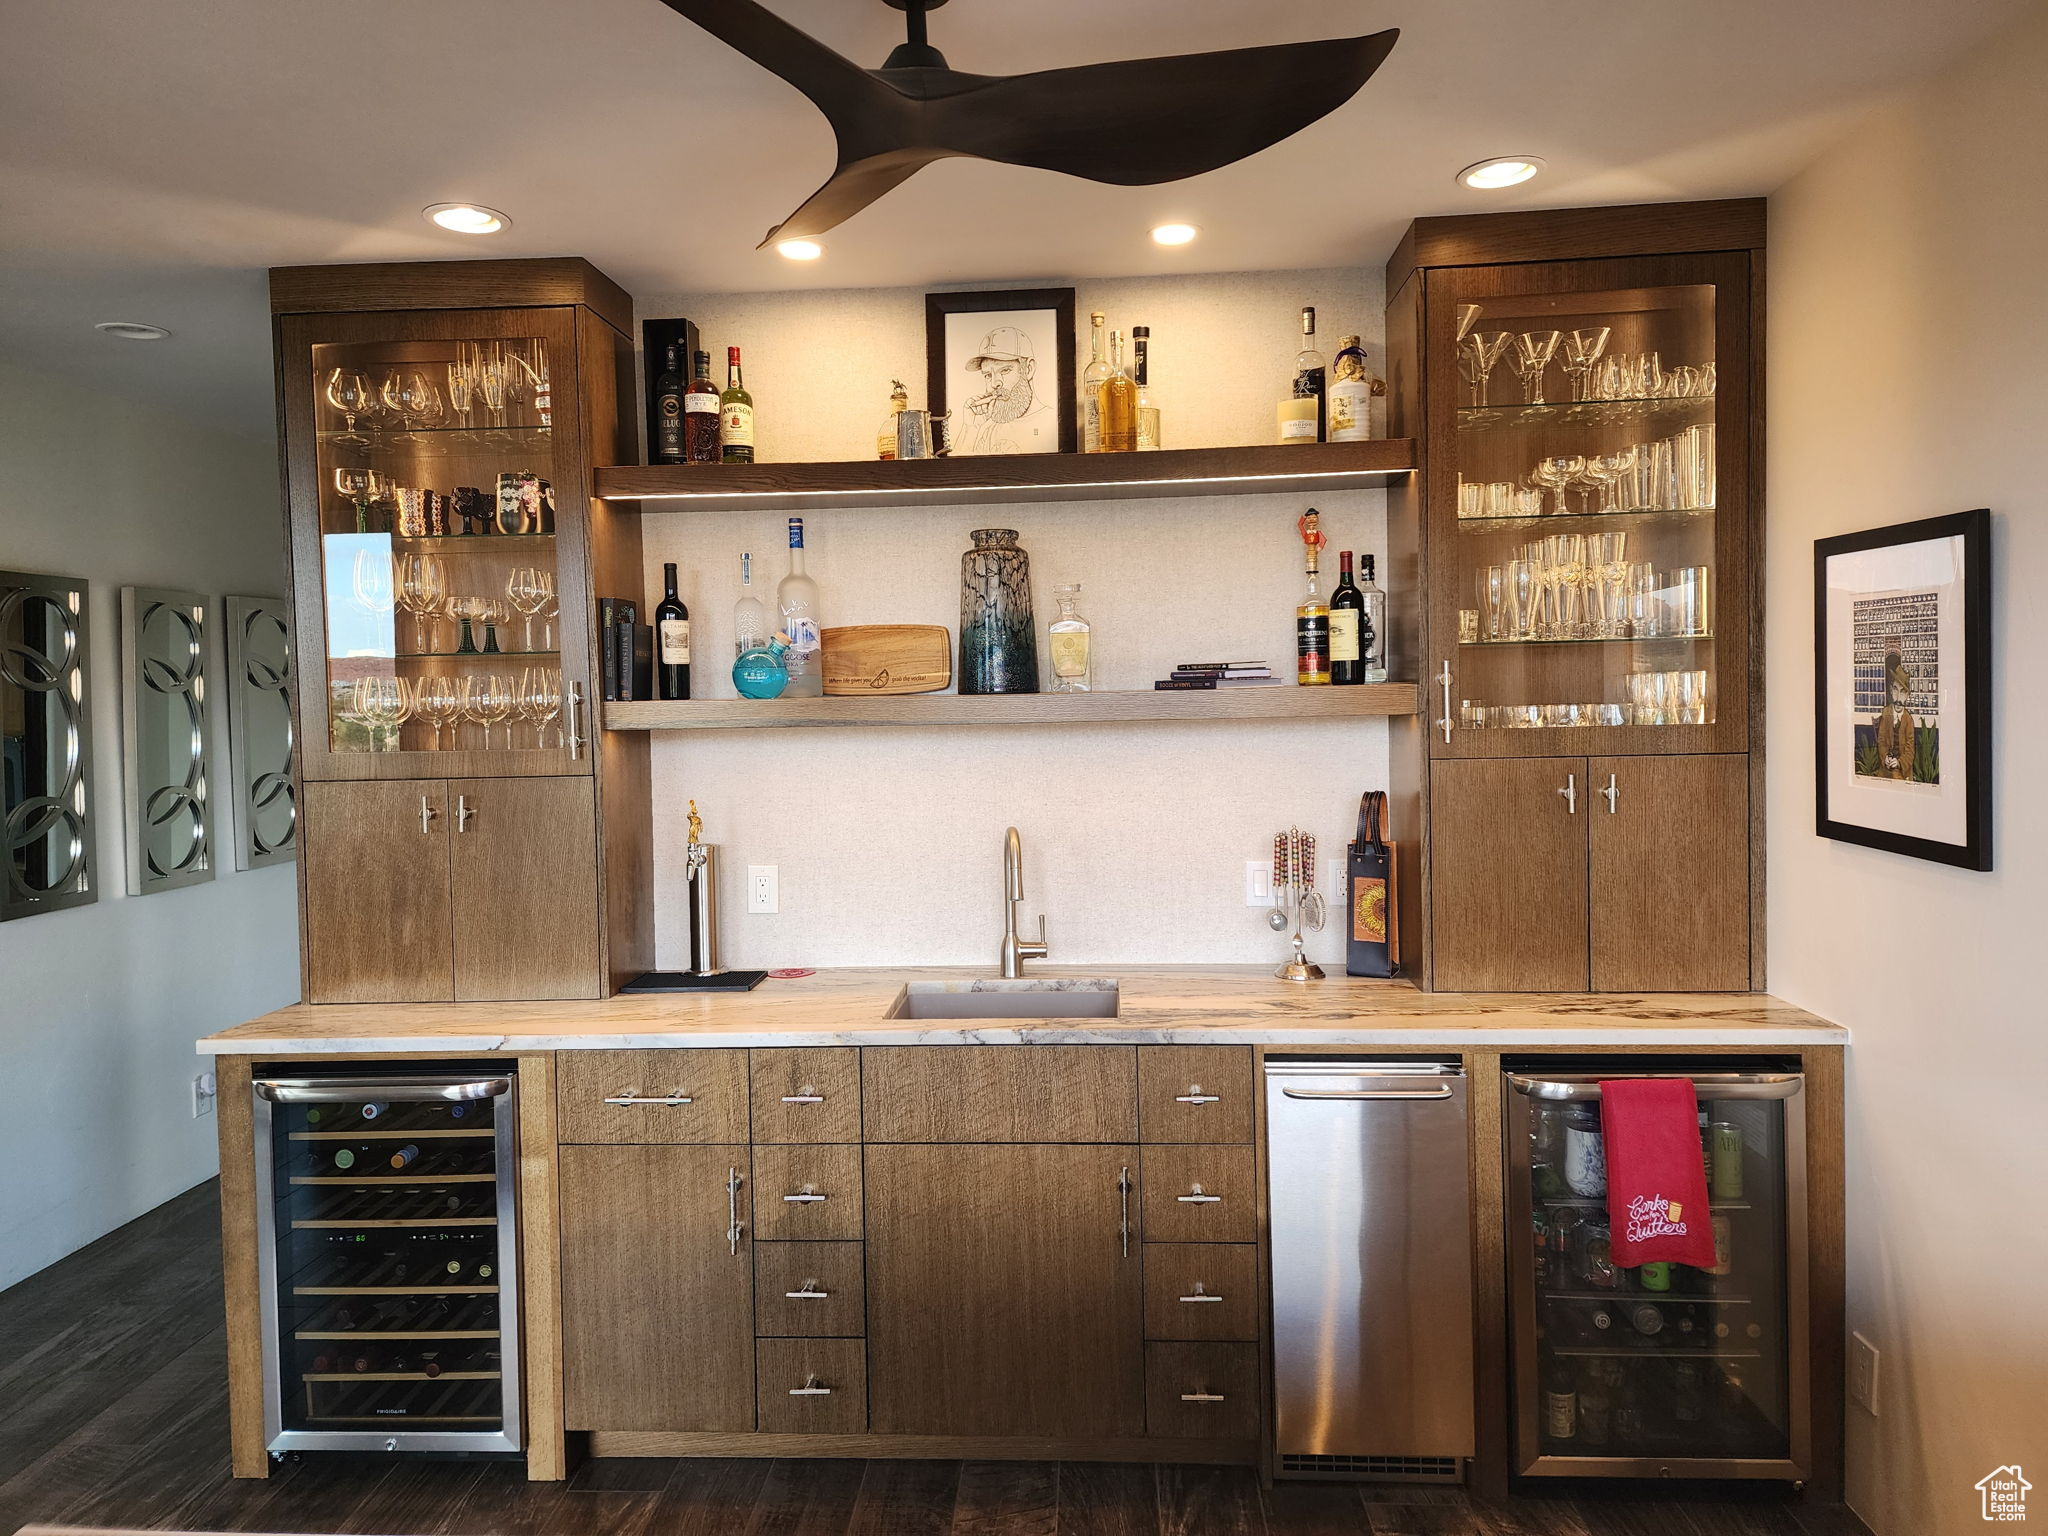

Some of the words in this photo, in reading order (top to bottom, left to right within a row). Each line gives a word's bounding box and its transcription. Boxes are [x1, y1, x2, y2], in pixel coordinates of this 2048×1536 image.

[722, 405, 752, 416] AMESON
[784, 653, 810, 661] GOOSE
[891, 676, 903, 684] grab
[1627, 1193, 1669, 1221] Corks
[1626, 1217, 1687, 1242] Quitters
